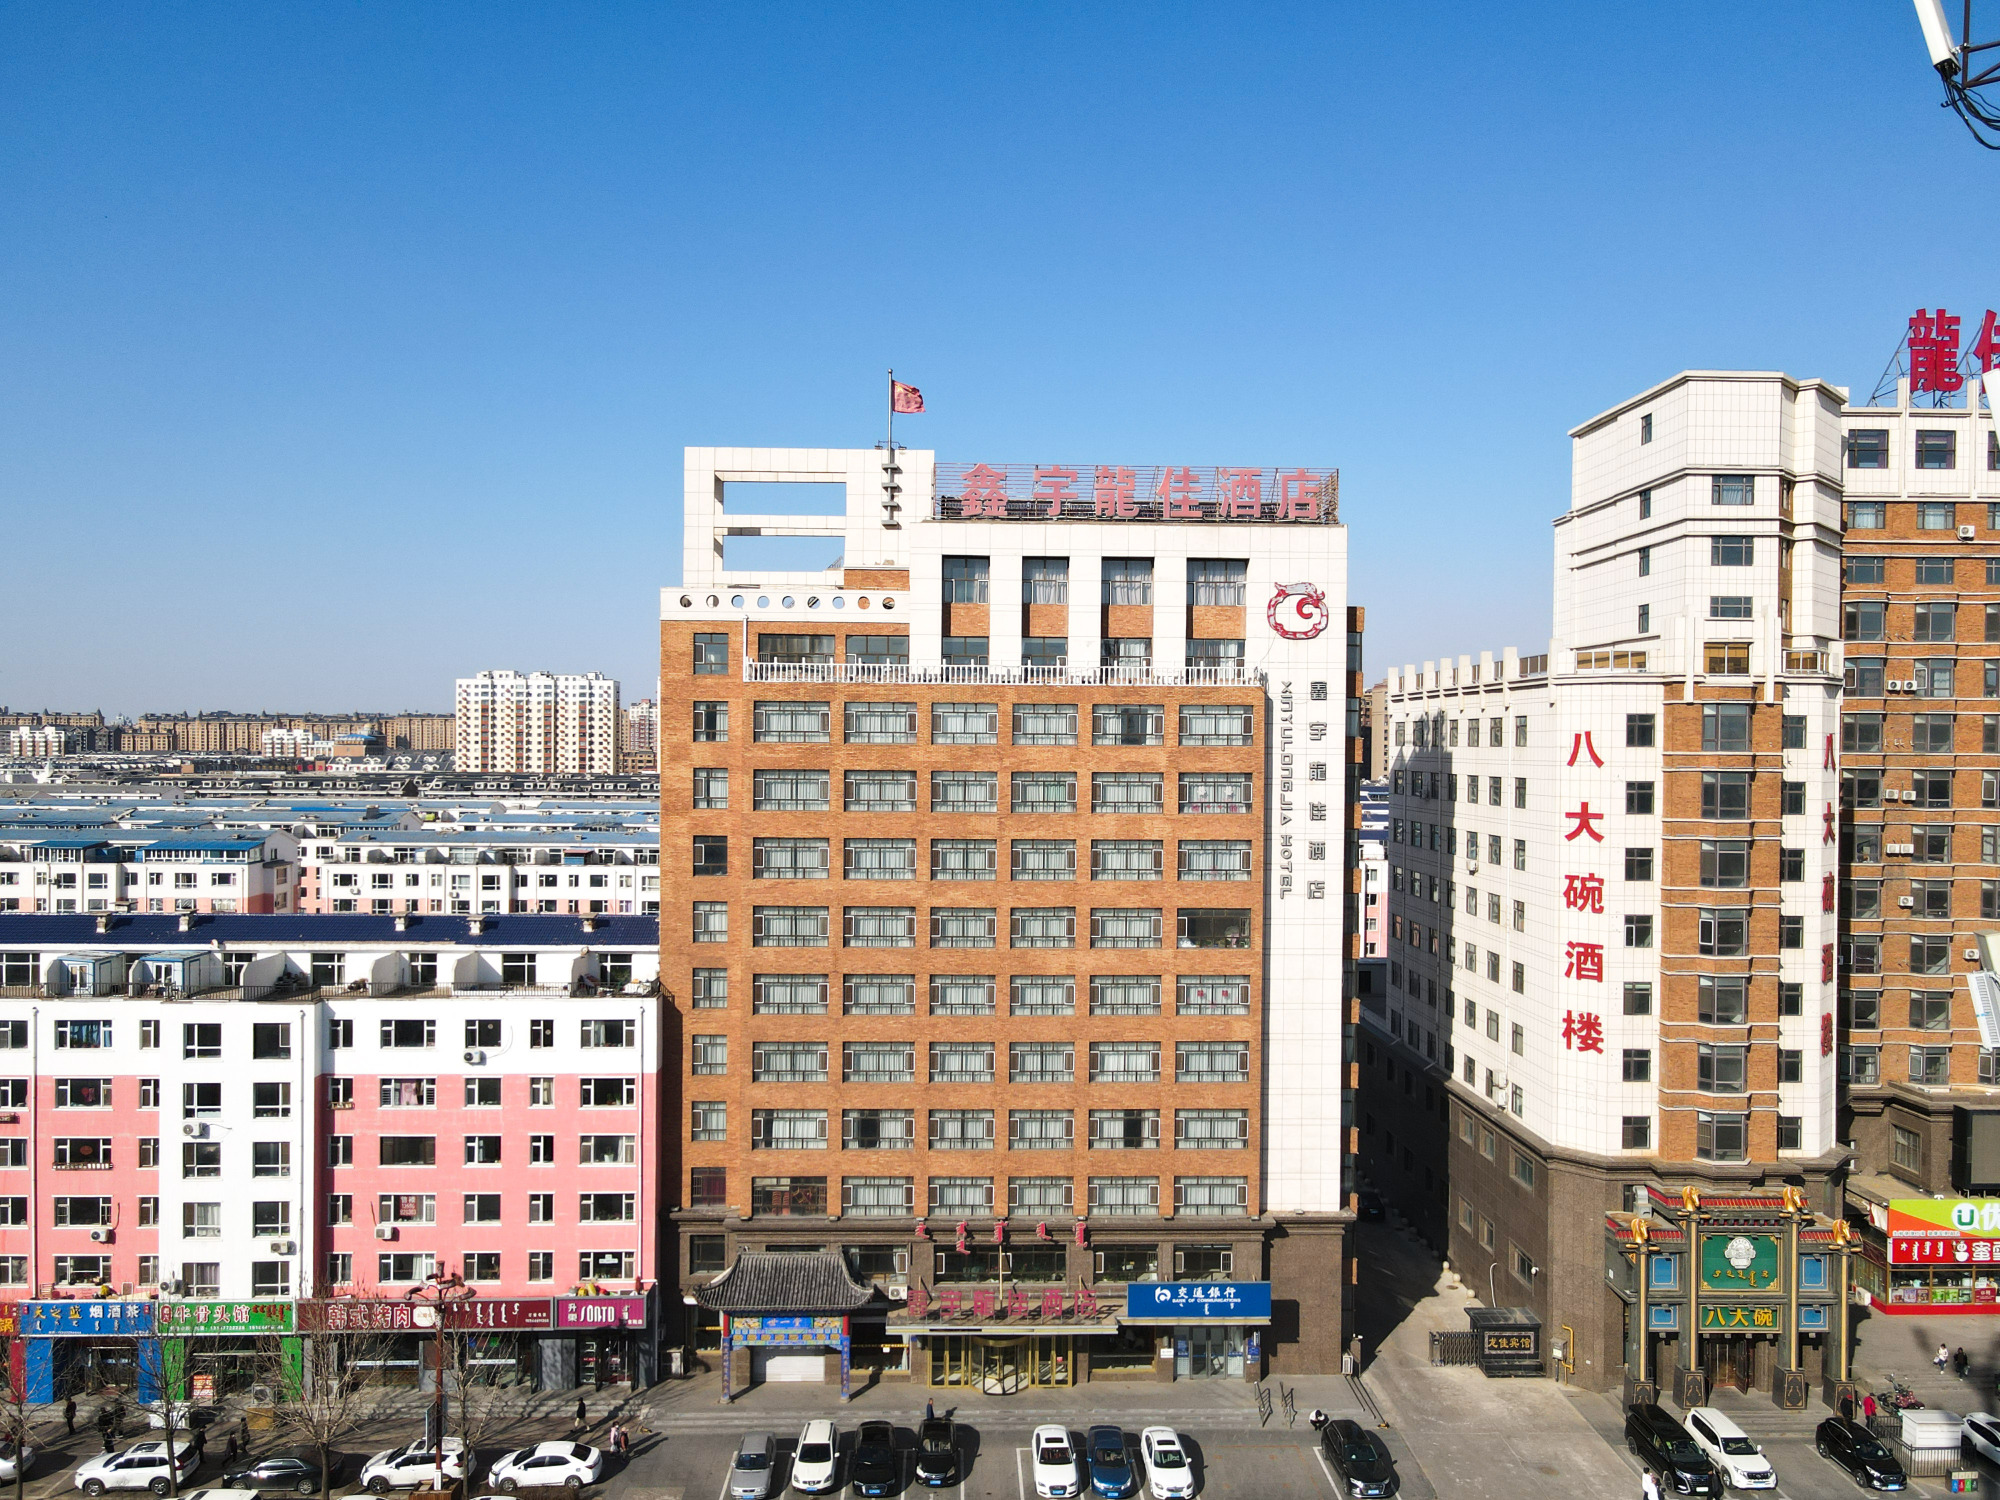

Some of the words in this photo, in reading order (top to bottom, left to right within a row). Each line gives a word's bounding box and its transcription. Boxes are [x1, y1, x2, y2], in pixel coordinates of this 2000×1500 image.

[960, 463, 1321, 519] 鑫宇龍佳酒店
[1280, 834, 1293, 899] HOTEL
[1562, 730, 1604, 1054] 八大碗酒楼
[1178, 1286, 1236, 1298] 交通銀行
[175, 1304, 250, 1323] 牛骨头馆
[327, 1303, 411, 1329] 韩式烤肉
[1705, 1308, 1773, 1326] 八大碗
[1488, 1337, 1531, 1348] 龙佳宾馆
